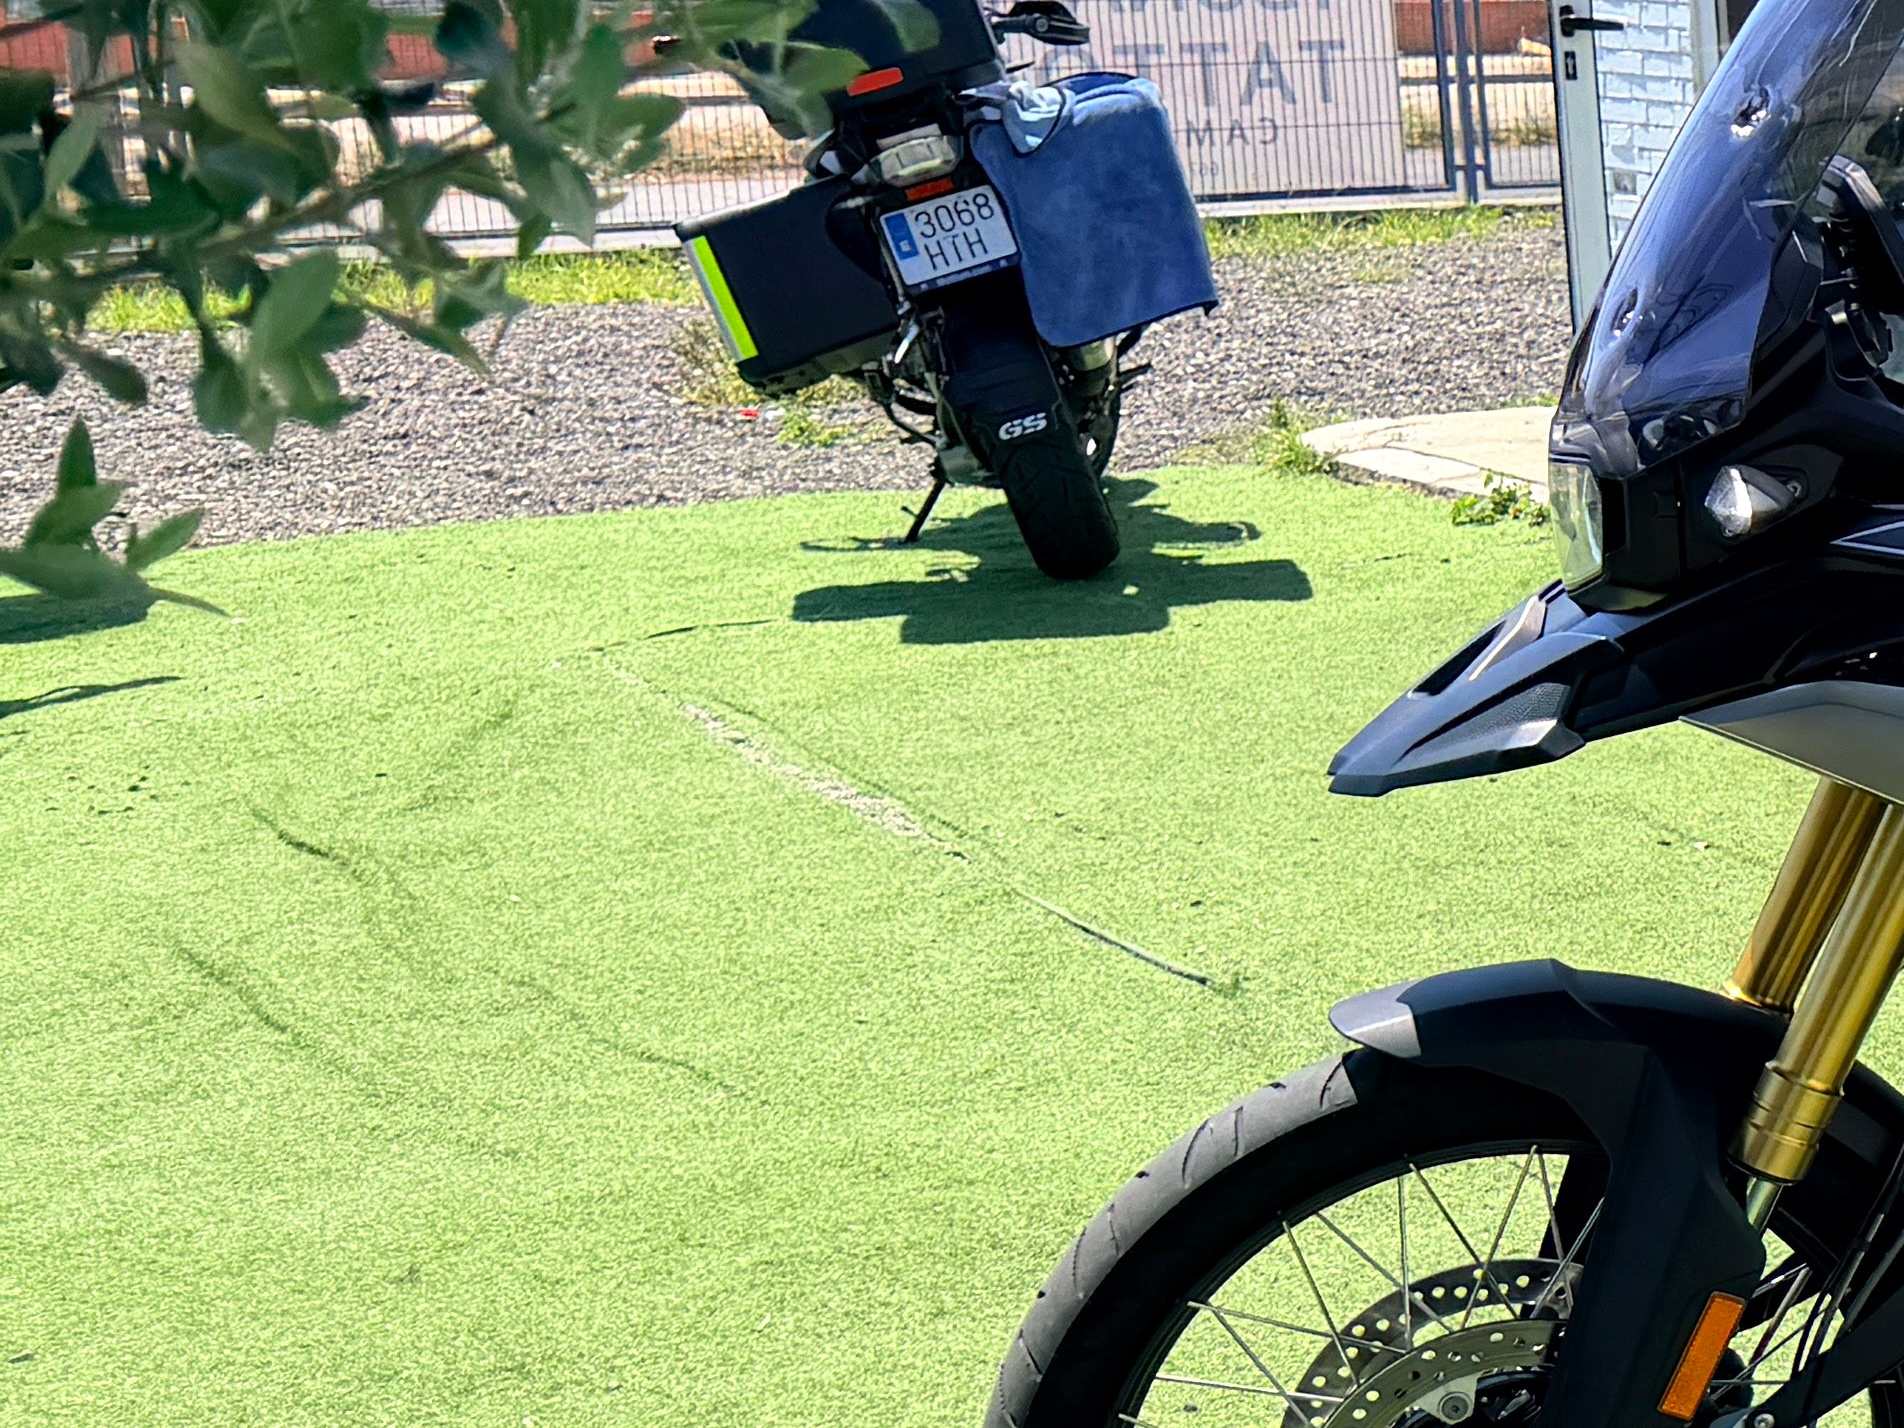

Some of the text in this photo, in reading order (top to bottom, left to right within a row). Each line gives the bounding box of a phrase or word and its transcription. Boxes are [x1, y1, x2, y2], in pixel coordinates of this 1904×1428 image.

[914, 192, 995, 239] 3068
[924, 227, 989, 271] HTH
[999, 412, 1047, 441] GS
